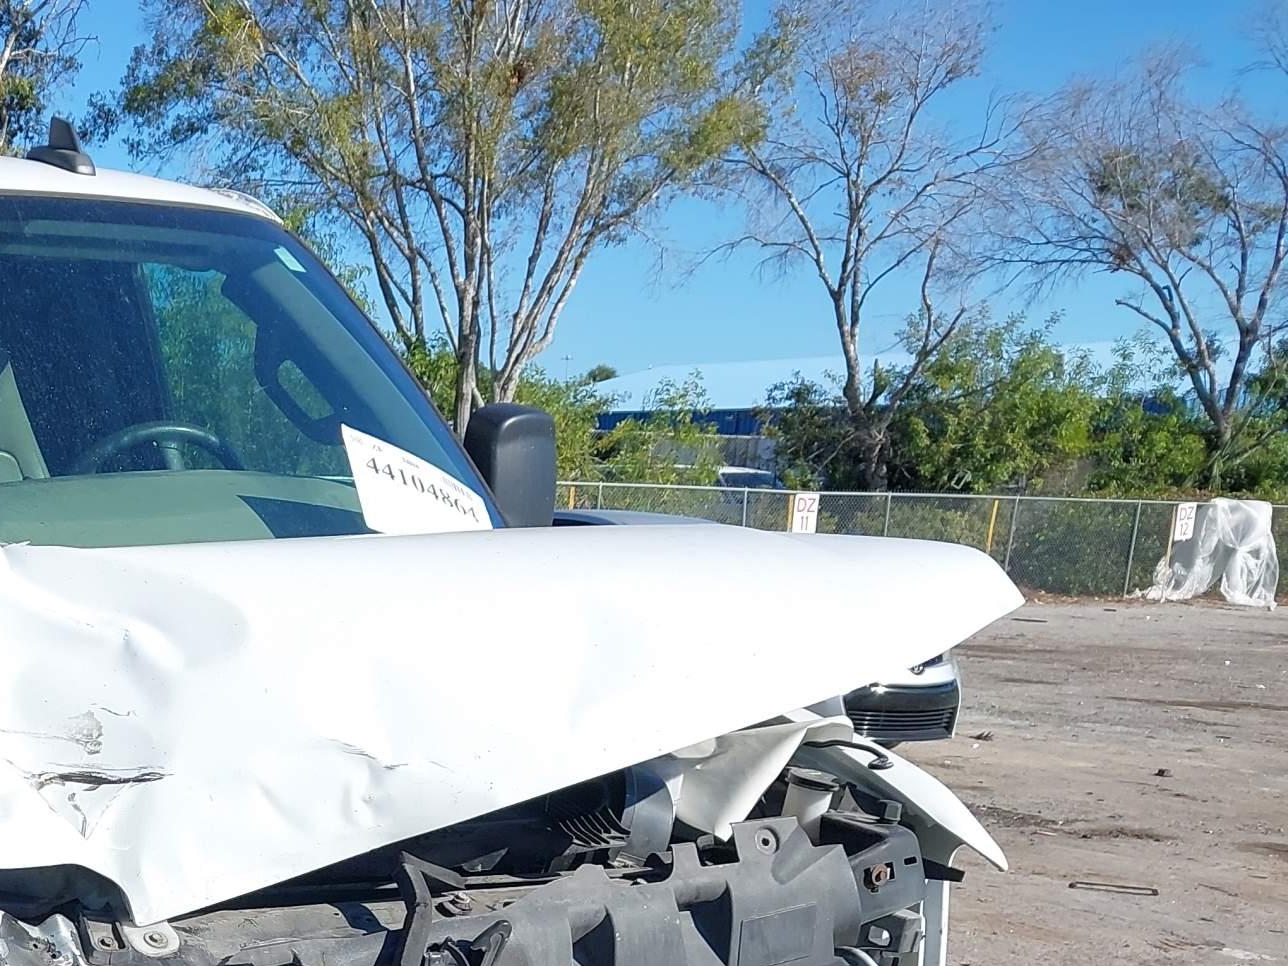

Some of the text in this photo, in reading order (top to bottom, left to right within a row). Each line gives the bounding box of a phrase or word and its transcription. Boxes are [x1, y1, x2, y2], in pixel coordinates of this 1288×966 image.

[796, 497, 816, 513] DZ
[1179, 506, 1194, 521] DZ
[800, 515, 809, 531] 11
[1179, 523, 1190, 536] 12
